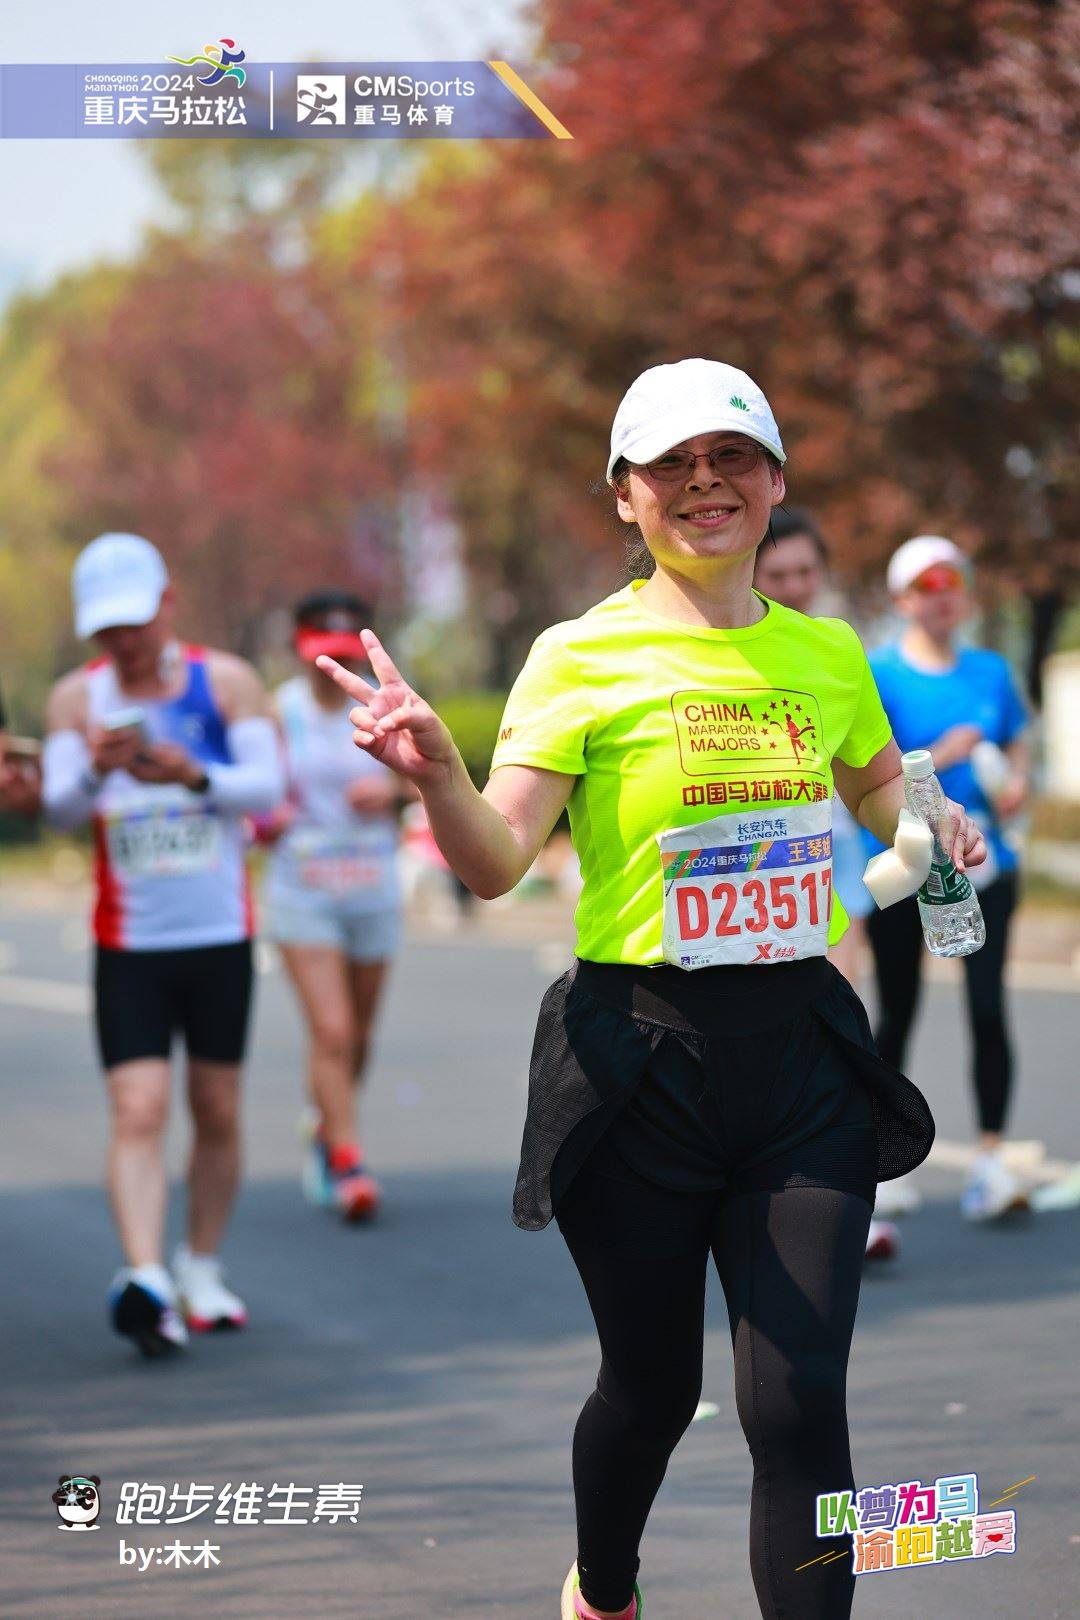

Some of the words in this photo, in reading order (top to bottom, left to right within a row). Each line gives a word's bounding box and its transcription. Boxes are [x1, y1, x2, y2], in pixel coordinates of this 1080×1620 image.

[684, 703, 754, 723] CHINA
[688, 724, 758, 736] MARATHON
[690, 737, 761, 753] MAJORS
[737, 818, 787, 834] 长安汽车
[738, 829, 788, 842] CHANGAN
[675, 867, 832, 941] D23517
